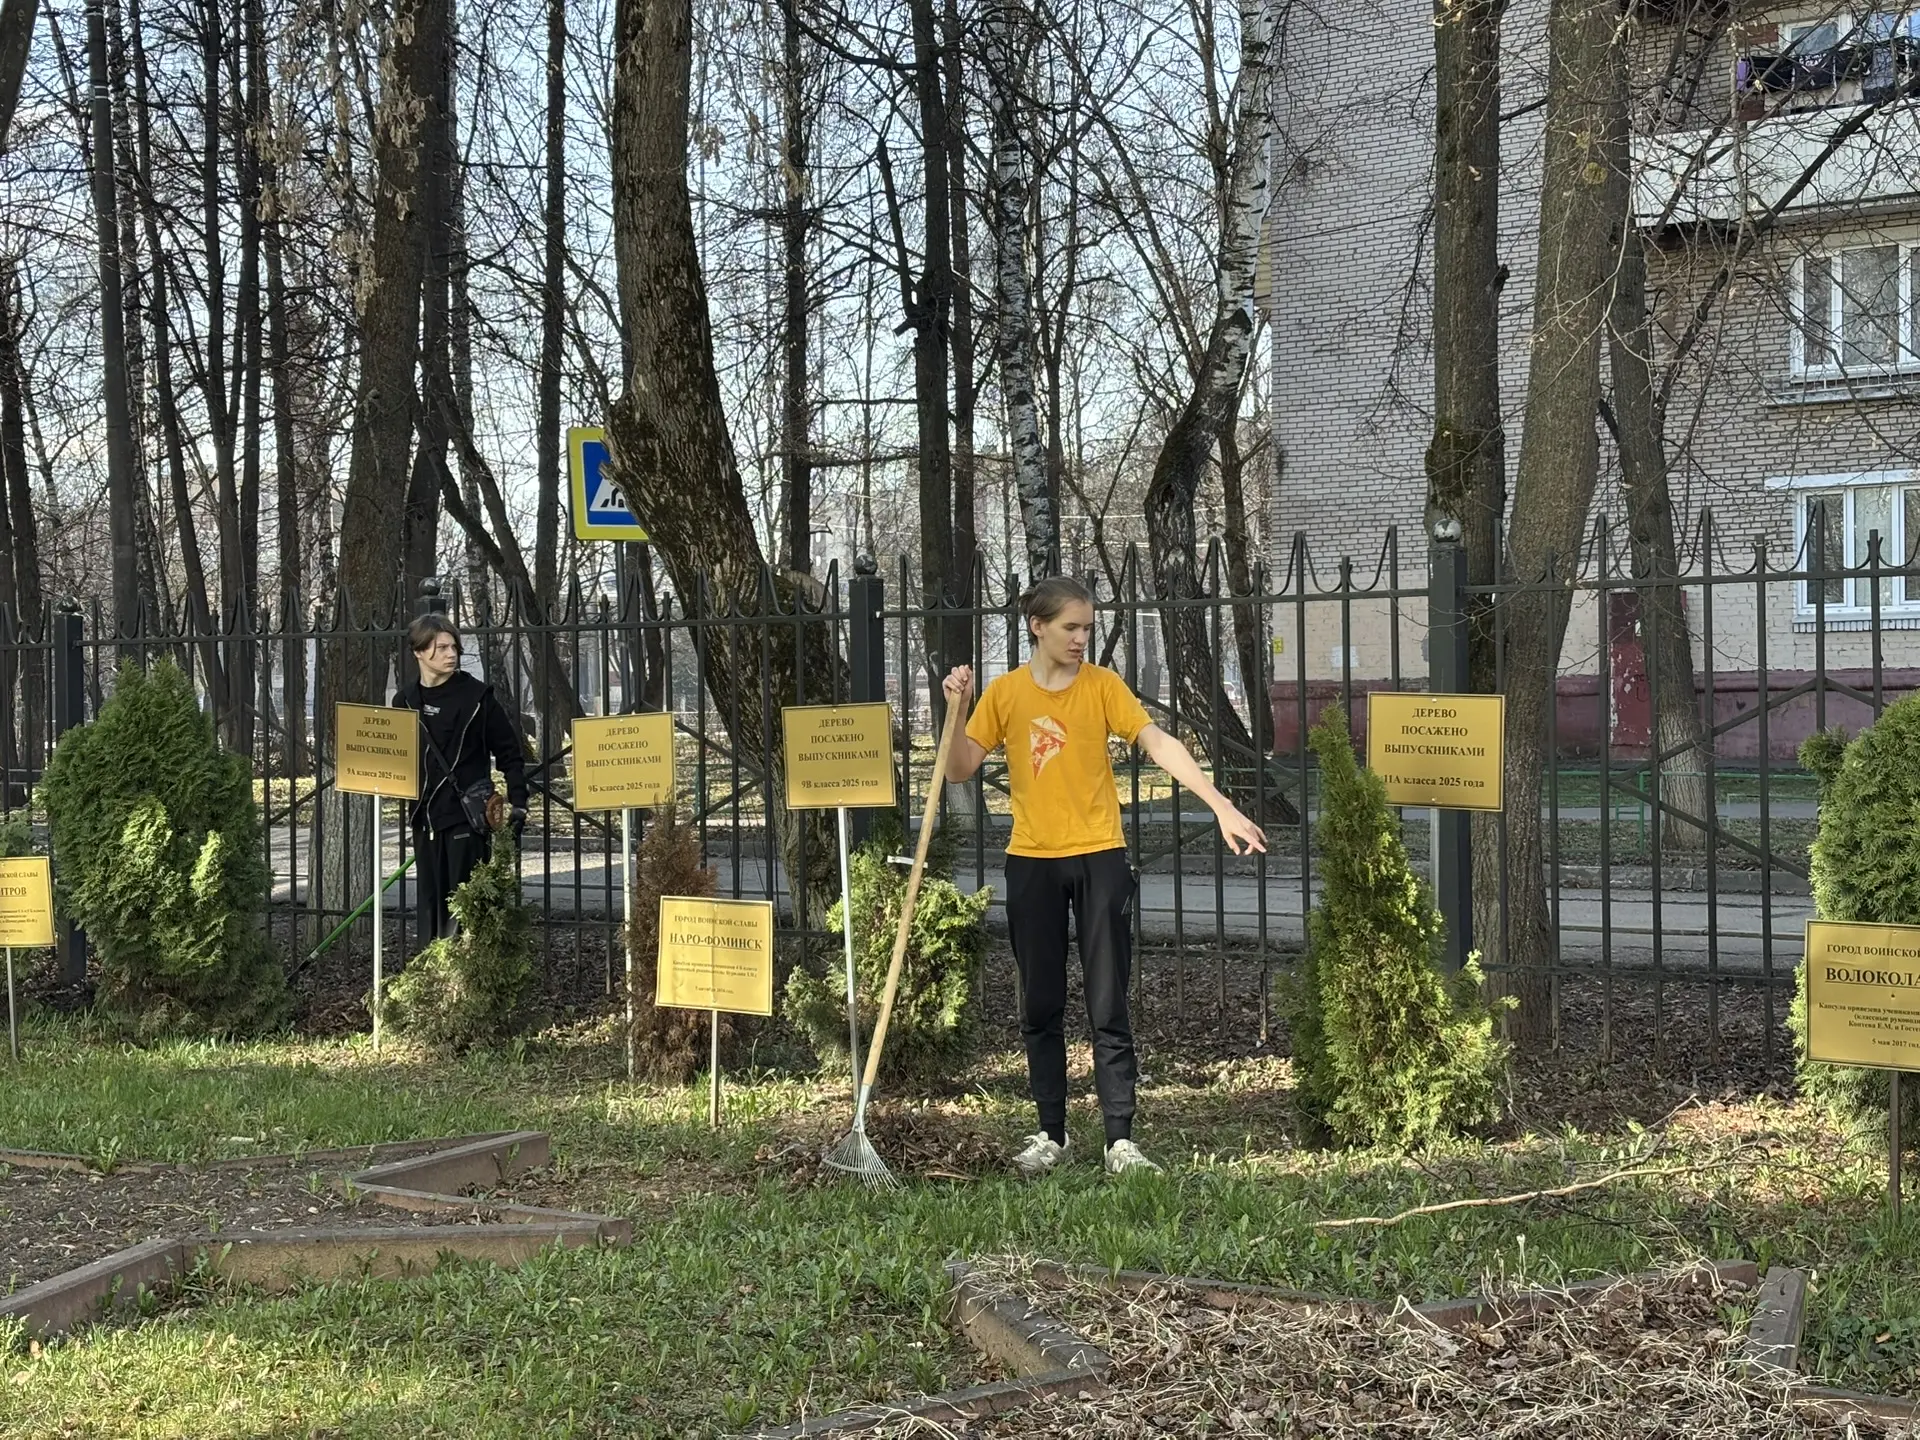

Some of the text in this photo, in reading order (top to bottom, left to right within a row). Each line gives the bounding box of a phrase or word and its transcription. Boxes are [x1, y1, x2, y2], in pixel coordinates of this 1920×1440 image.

[1412, 708, 1457, 718] ДЕРЕВО
[363, 717, 390, 726] ДЕРЕВО
[818, 718, 854, 728] ДЕРЕВО
[356, 730, 398, 741] ПОСАЖЕНО
[605, 726, 640, 737] ДЕРЕВО
[1401, 725, 1468, 736] ПОСАЖЕНО
[810, 733, 864, 744] ПОСАЖЕНО
[346, 744, 408, 757] ВЫПУСКНИКАМИ
[598, 740, 648, 751] ПОСАЖЕНО
[1384, 744, 1485, 757] ВЫПУСКНИКАМИ
[798, 750, 879, 762] ВЫПУСКНИКАМИ
[586, 756, 661, 768] ВЫПУСКНИКАМИ
[378, 771, 392, 780] 2025
[1383, 774, 1484, 788] 11А класса 2025 года
[588, 784, 598, 792] 9Б
[600, 784, 624, 792] класса
[626, 782, 643, 790] 2025
[801, 780, 812, 788] 9В
[814, 780, 840, 788] класса
[842, 779, 859, 787] 2025
[674, 915, 696, 924] ГОРОД
[670, 933, 762, 950] НАРО-ФОМИНСК
[1827, 944, 1861, 956] ГОРОД
[1819, 1002, 1846, 1011] Капсула
